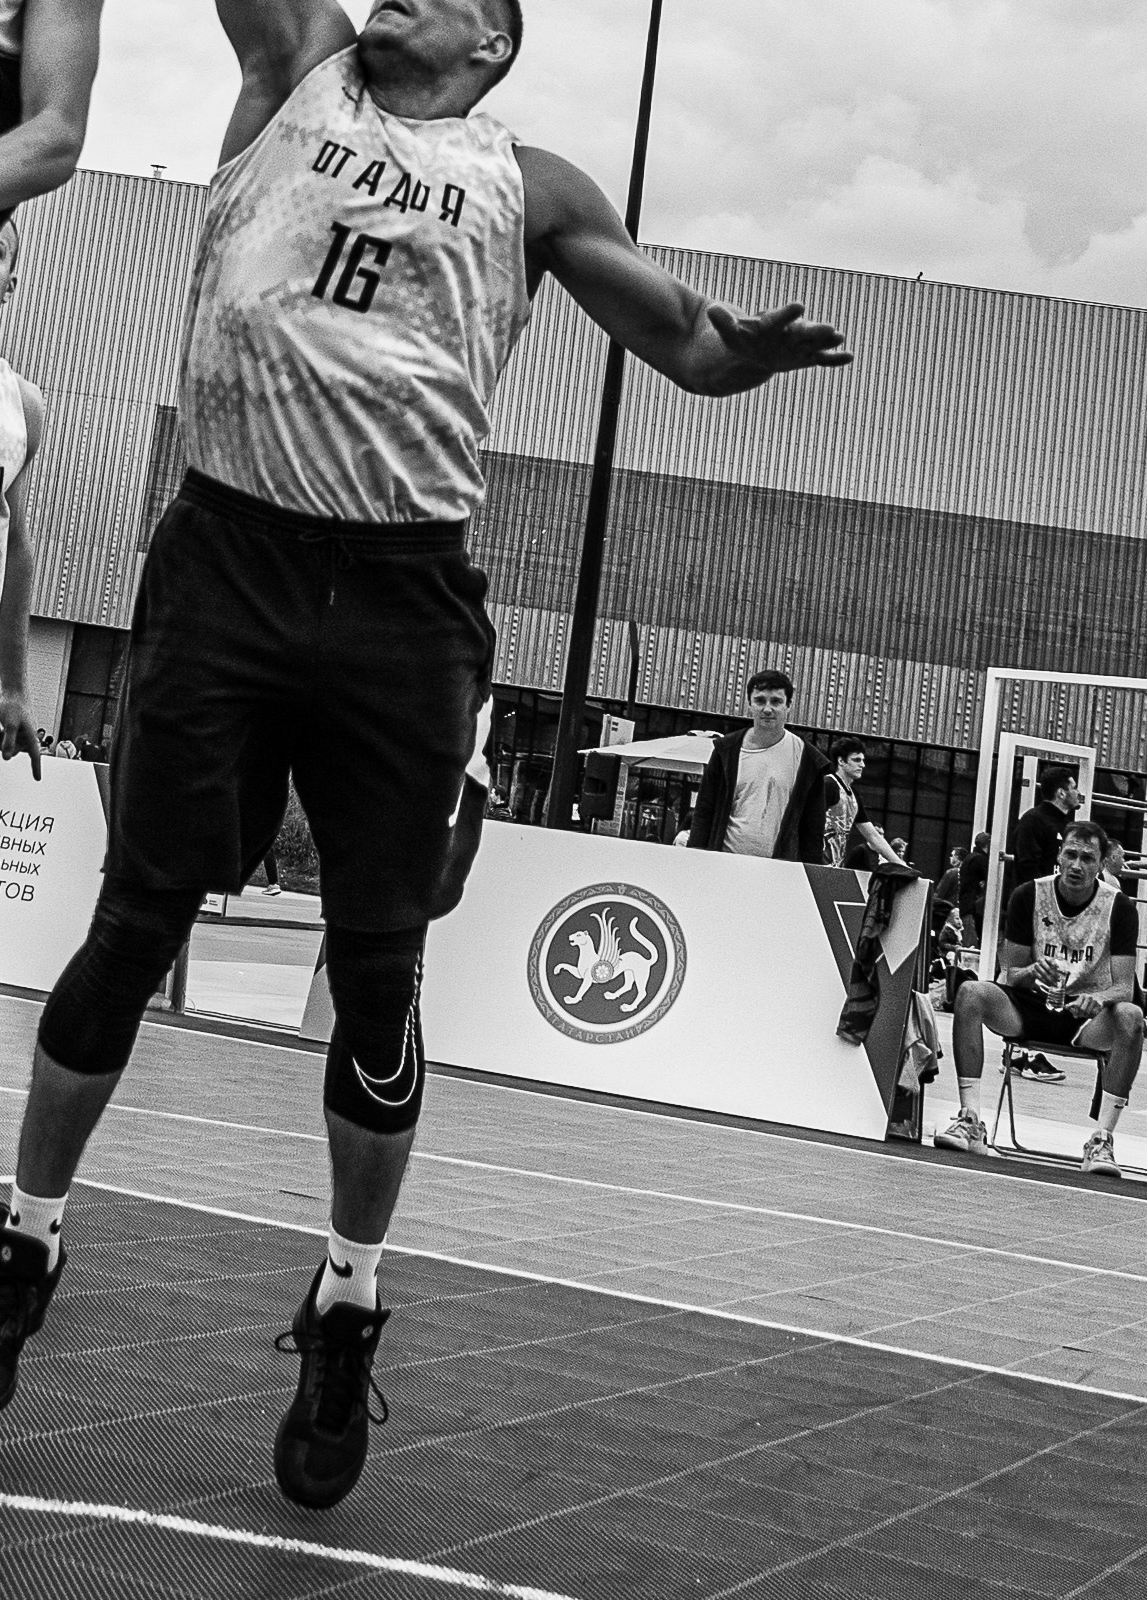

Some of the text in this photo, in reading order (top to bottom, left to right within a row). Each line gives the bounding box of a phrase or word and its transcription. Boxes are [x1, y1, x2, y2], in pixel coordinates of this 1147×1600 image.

[311, 140, 357, 178] ОТ
[352, 160, 386, 196] А
[438, 183, 466, 227] Я
[311, 221, 393, 314] 16
[1085, 946, 1093, 961] Я
